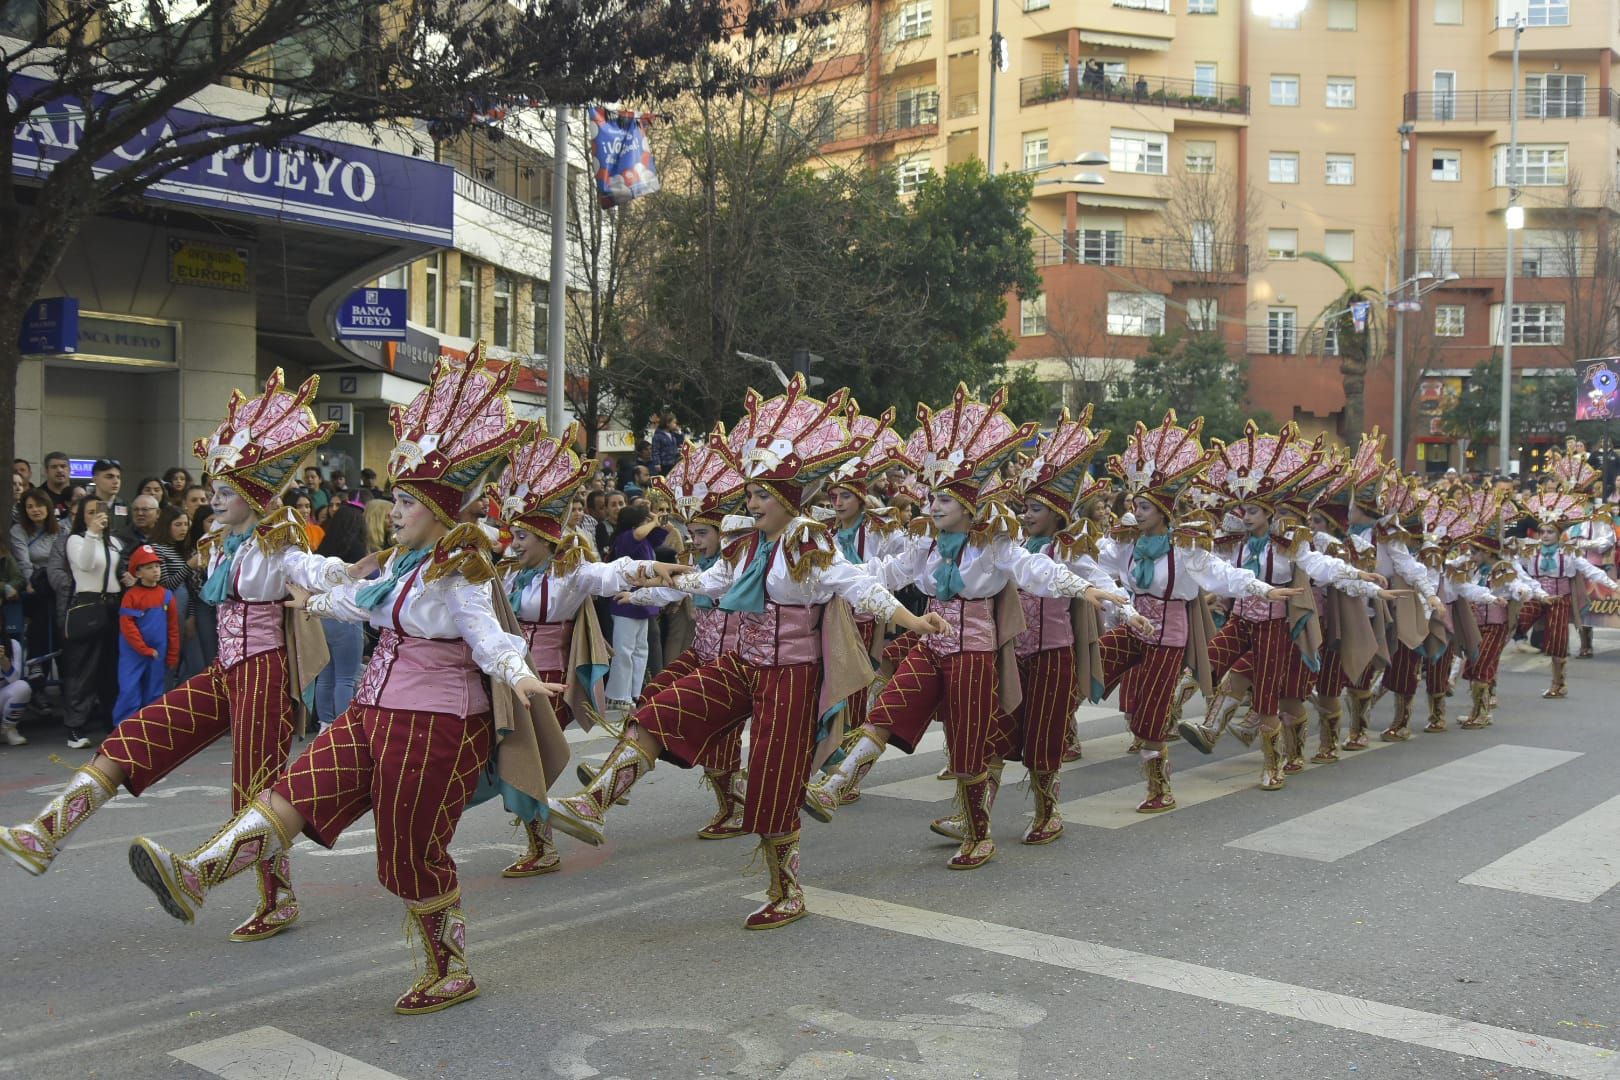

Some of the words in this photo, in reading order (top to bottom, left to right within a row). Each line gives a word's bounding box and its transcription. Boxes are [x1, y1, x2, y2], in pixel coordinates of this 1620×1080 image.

[207, 131, 376, 202] PUEYO
[177, 265, 241, 282] EUROPA
[352, 305, 392, 316] BANCA
[352, 316, 391, 326] PUEYO
